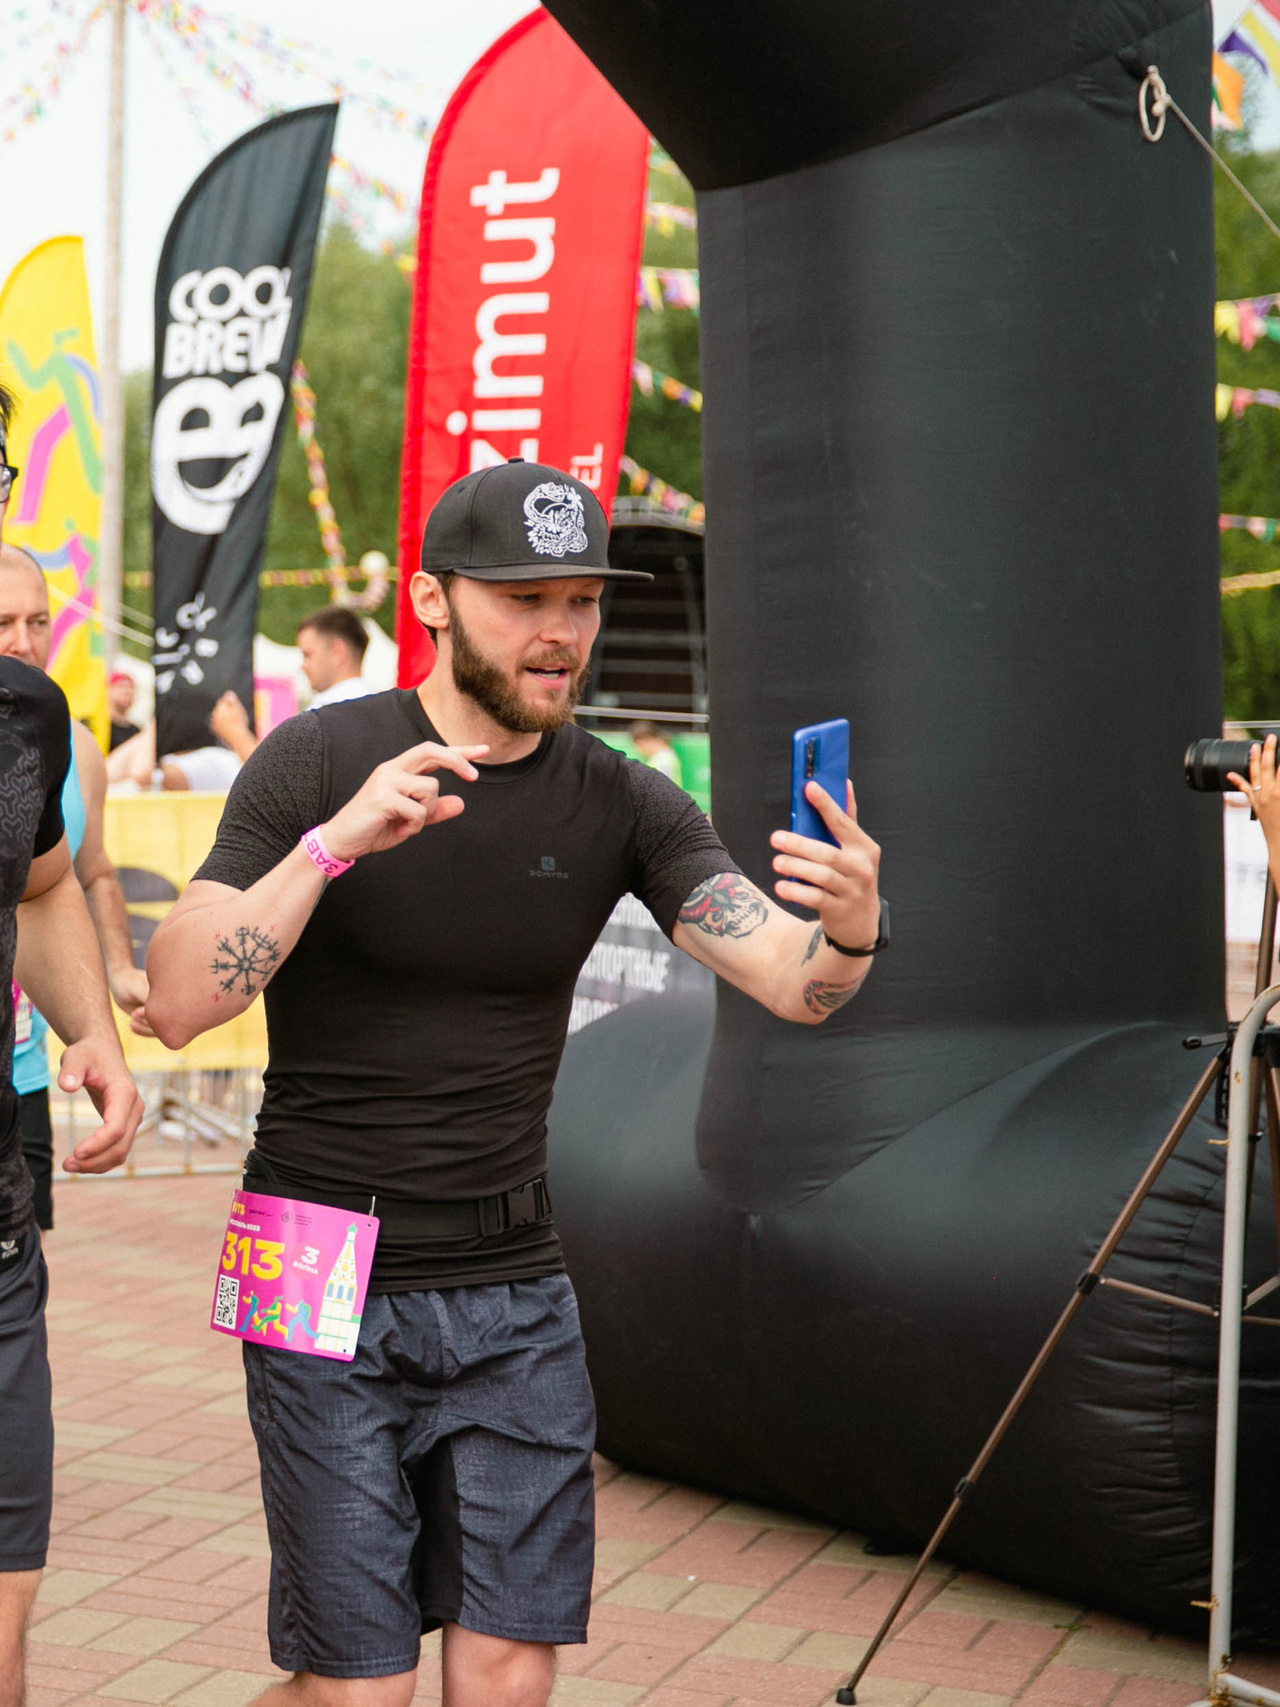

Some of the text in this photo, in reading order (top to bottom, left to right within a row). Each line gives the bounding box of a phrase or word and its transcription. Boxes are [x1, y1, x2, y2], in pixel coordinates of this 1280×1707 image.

[221, 1231, 285, 1280] 313
[301, 1245, 320, 1265] 3
[292, 1260, 319, 1276] ВОЛНА
